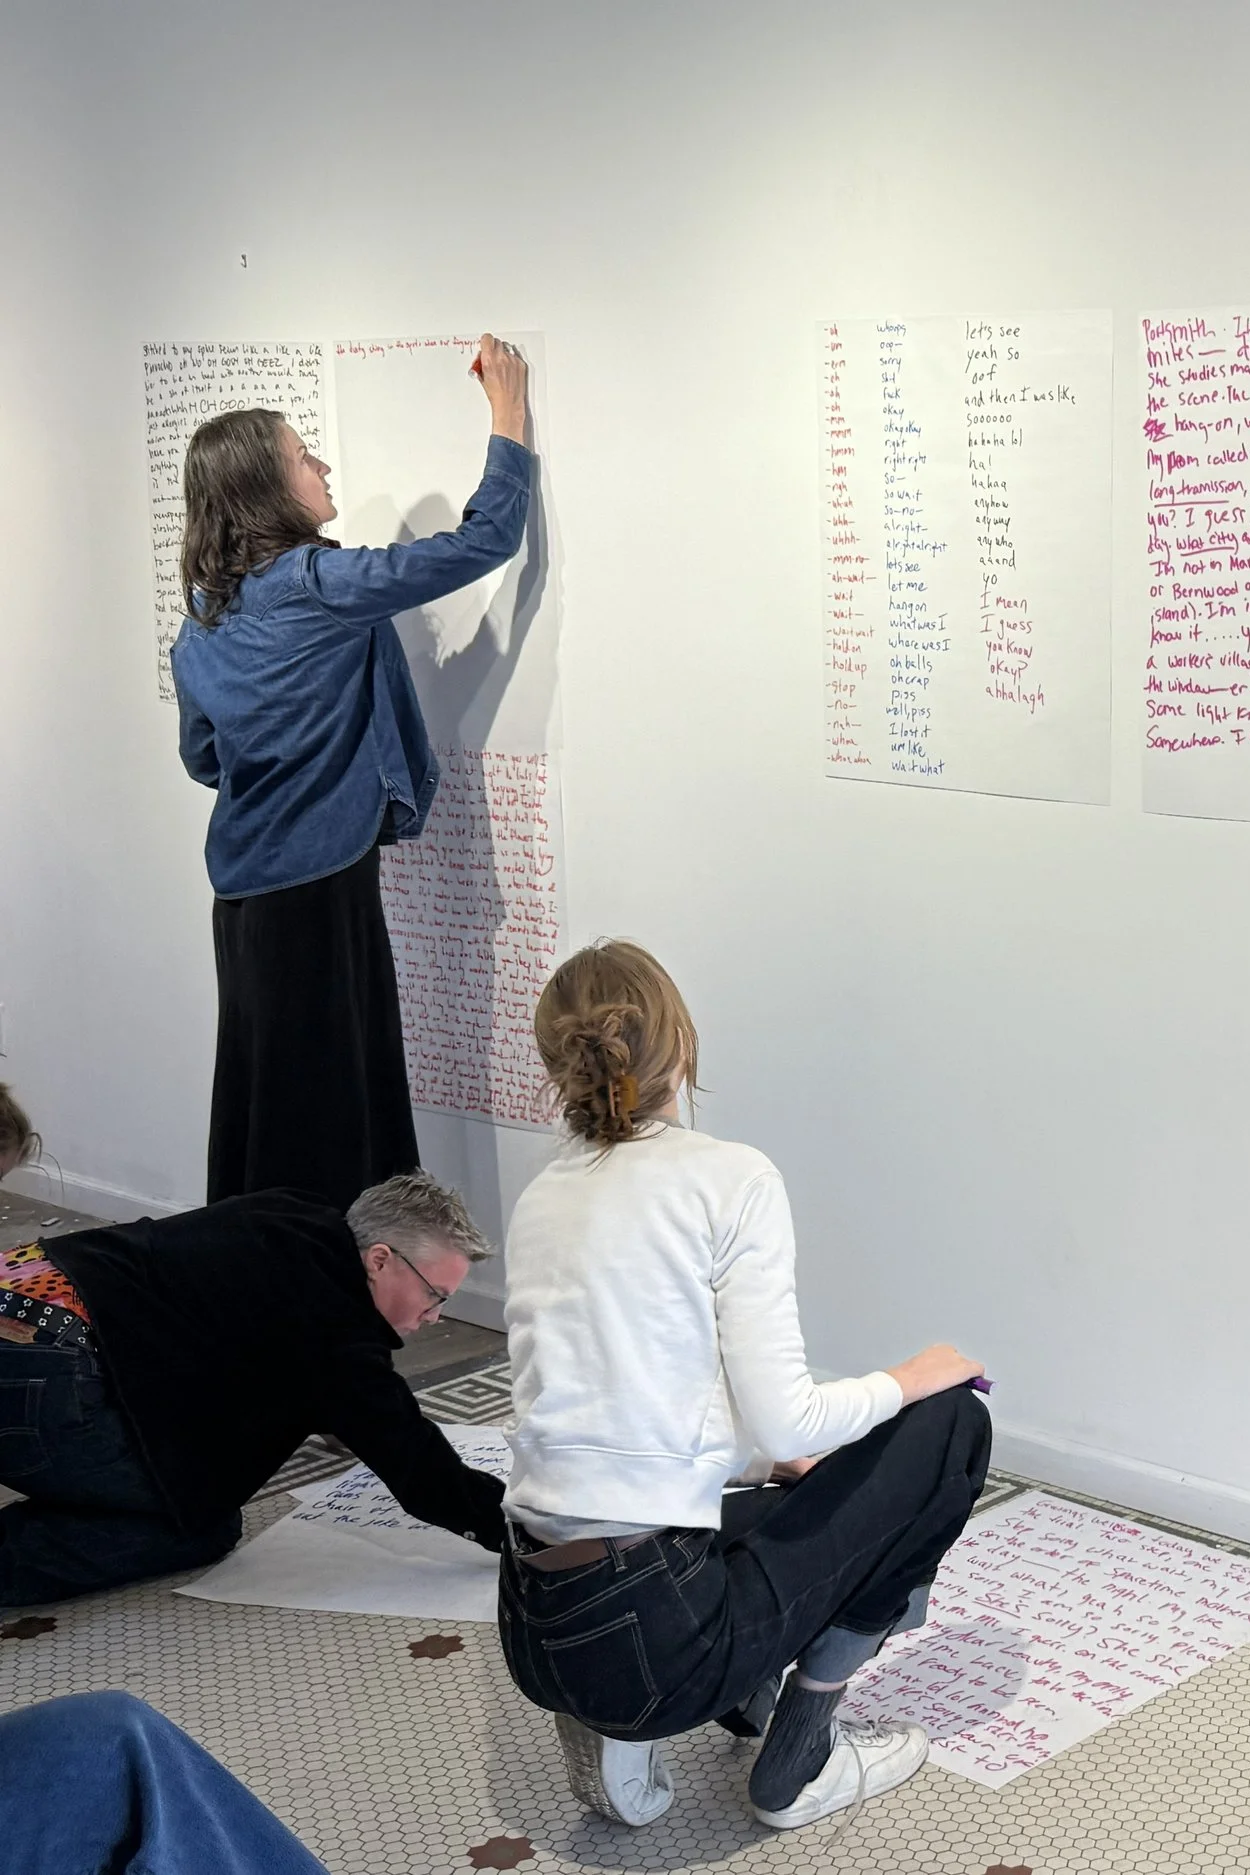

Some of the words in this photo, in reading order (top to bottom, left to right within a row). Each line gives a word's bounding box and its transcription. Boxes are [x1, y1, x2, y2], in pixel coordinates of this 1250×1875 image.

[1000, 327, 1020, 337] see
[965, 345, 997, 373] yeah
[965, 394, 985, 407] and
[990, 389, 1016, 403] then
[980, 592, 991, 610] I
[997, 596, 1027, 612] mean
[980, 614, 995, 633] I
[1000, 619, 1032, 639] guess
[906, 656, 933, 672] balls
